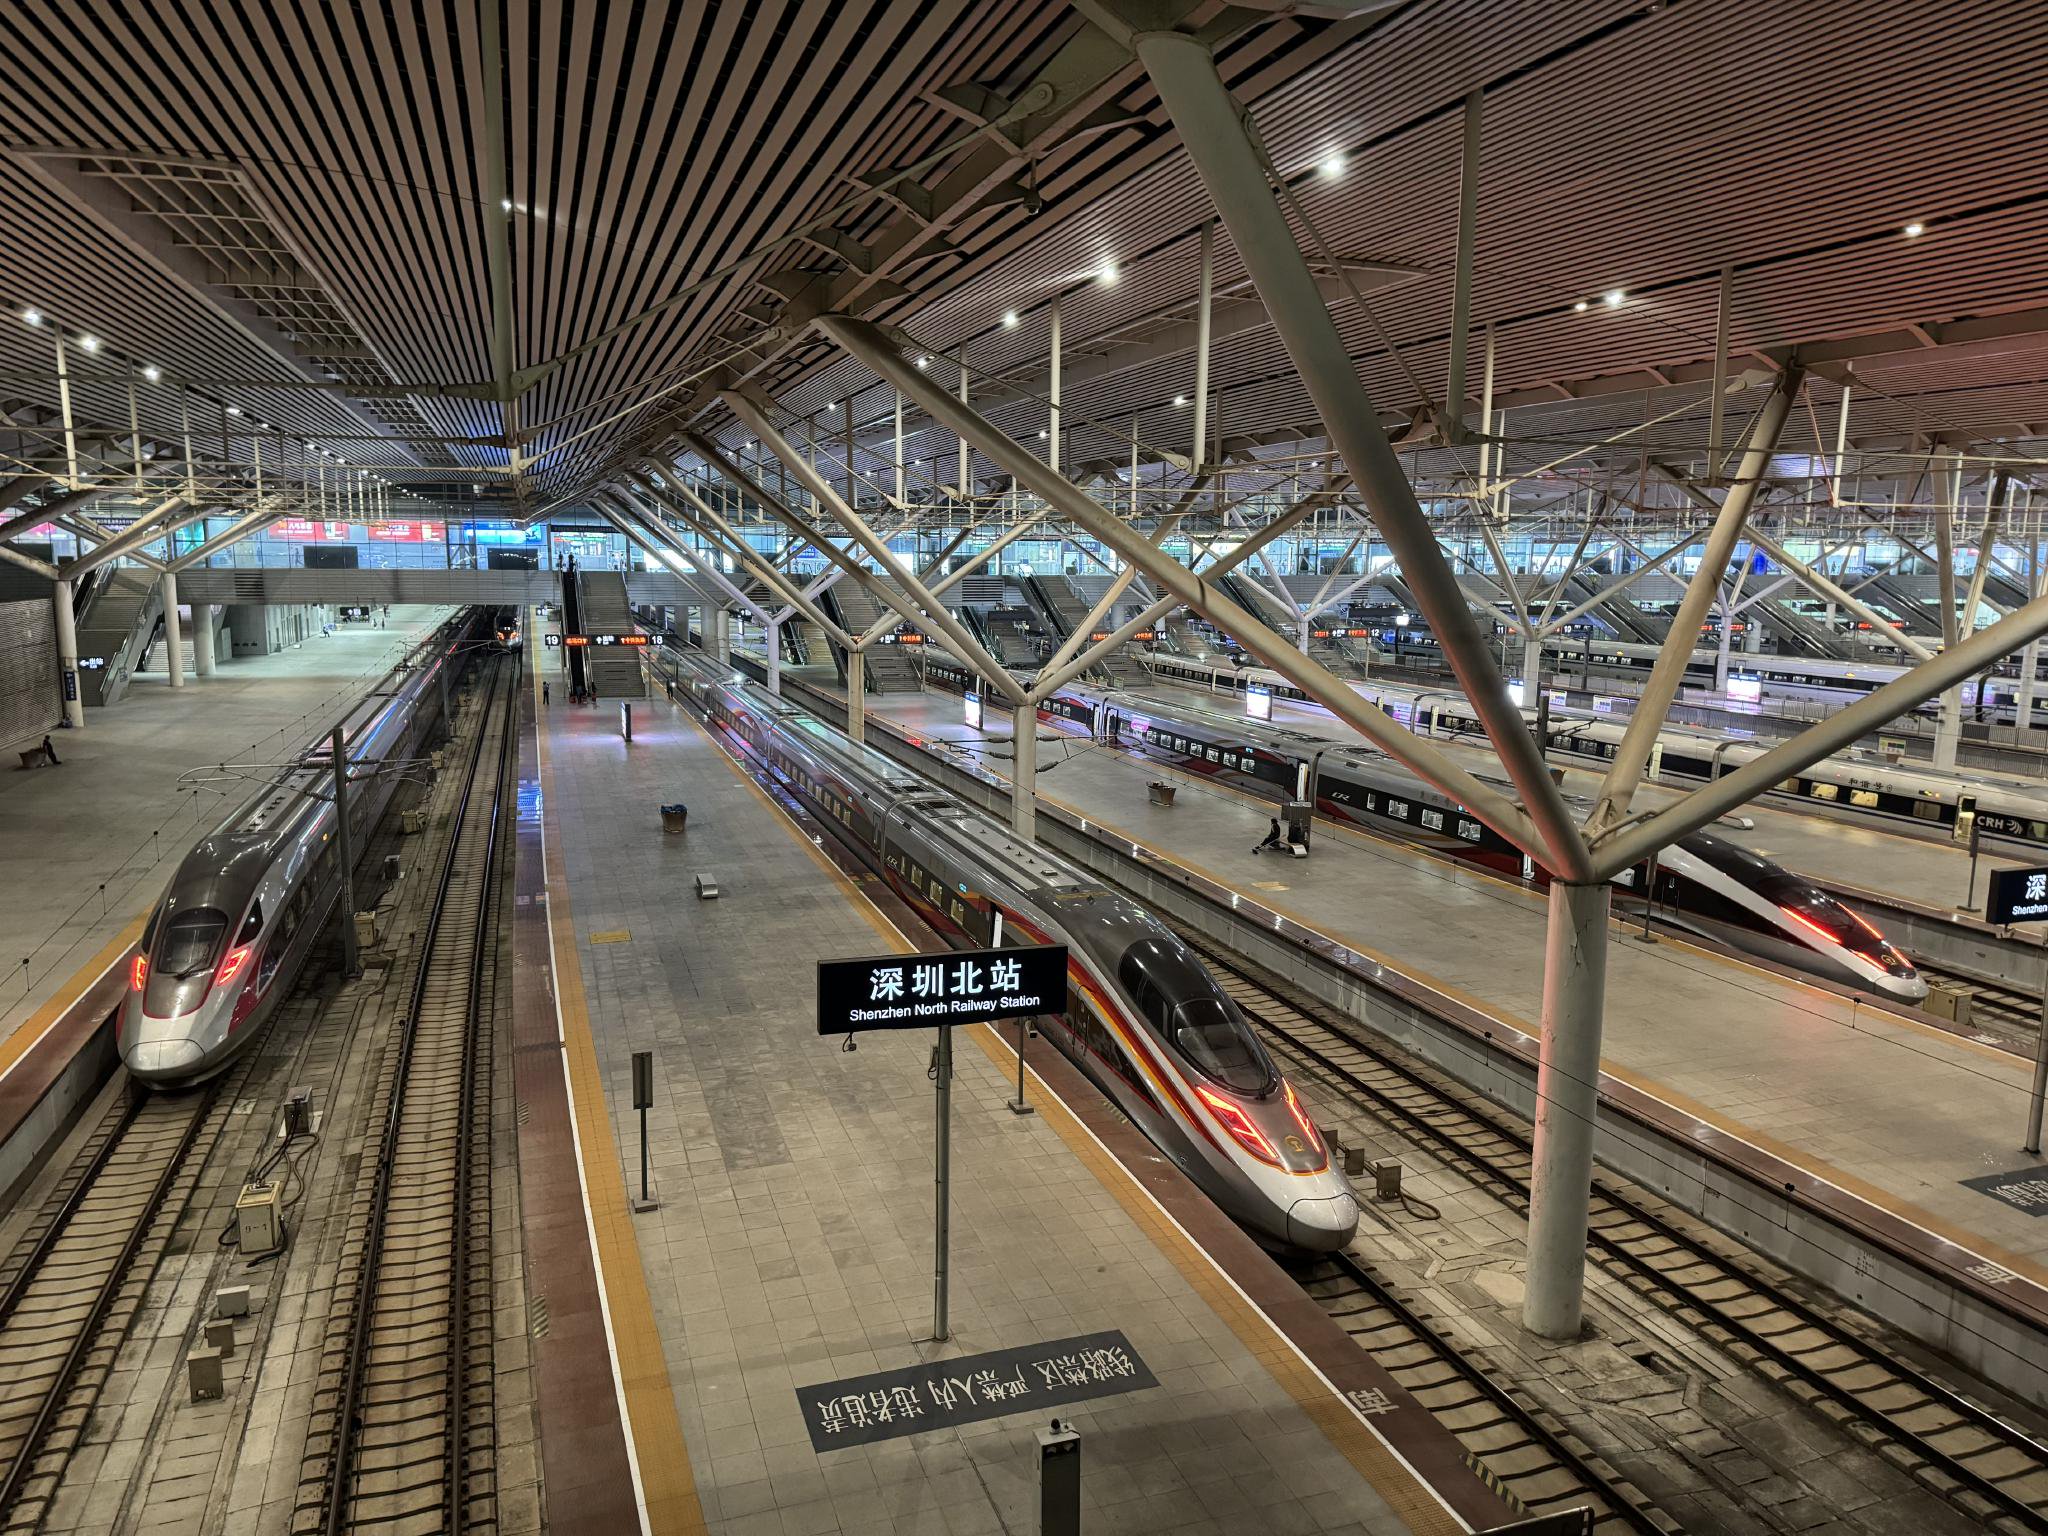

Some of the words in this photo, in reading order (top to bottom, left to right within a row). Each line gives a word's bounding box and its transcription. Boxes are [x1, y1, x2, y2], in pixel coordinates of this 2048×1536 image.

[546, 635, 559, 645] 19
[651, 635, 663, 644] 18
[1157, 631, 1167, 640] 14
[1371, 629, 1380, 637] 12
[1977, 815, 2004, 830] CRH
[2025, 874, 2047, 900] 深
[2012, 904, 2048, 916] Shenzhen
[869, 958, 1022, 1001] 深圳北站
[849, 1005, 911, 1022] Shenzhen
[914, 1002, 948, 1016] North
[951, 998, 997, 1014] Railway
[1000, 995, 1040, 1009] Station
[1032, 1346, 1136, 1391] 线路禁区
[817, 1385, 925, 1434] 违者追责
